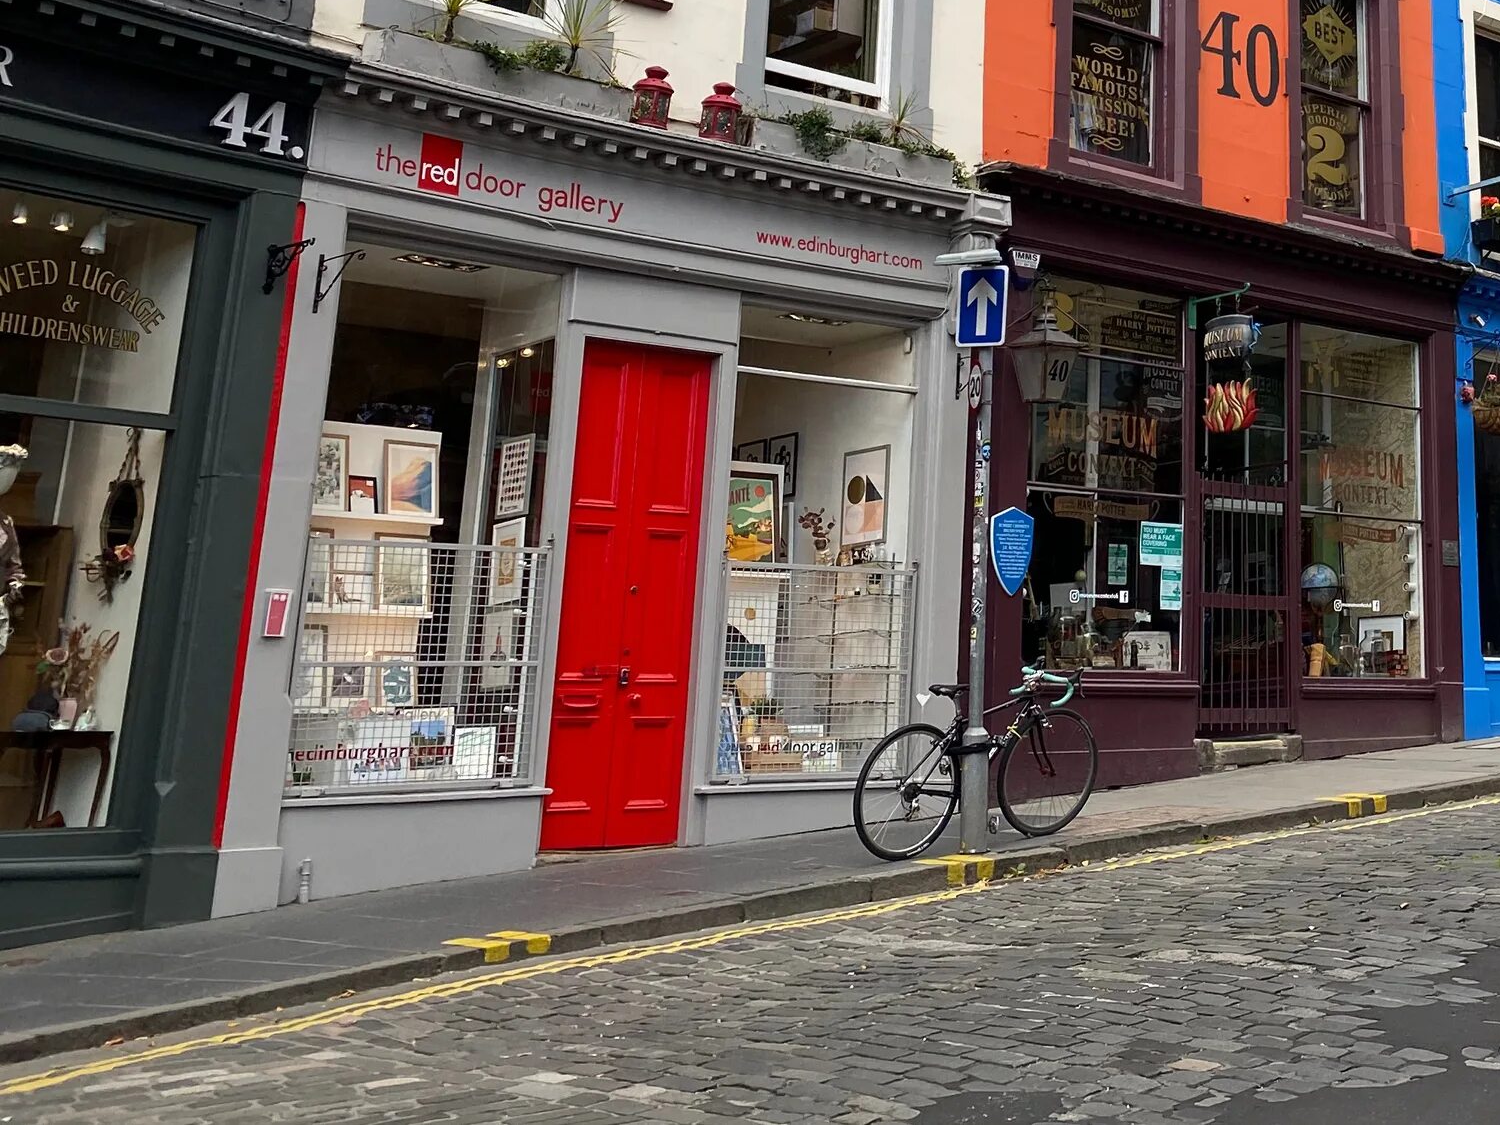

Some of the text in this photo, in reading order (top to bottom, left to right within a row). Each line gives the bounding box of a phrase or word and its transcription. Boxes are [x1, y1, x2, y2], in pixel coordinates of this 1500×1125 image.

[1314, 21, 1346, 46] BEST
[1076, 54, 1138, 84] WORLD
[1201, 11, 1280, 107] 40
[1071, 92, 1149, 121] MISSION
[1087, 113, 1136, 138] REE!
[1306, 125, 1347, 186] 2
[376, 143, 624, 224] the red door gallery
[1015, 252, 1038, 262] IMMS
[61, 294, 80, 314] &
[68, 260, 166, 334] LUGGAGE
[1116, 318, 1143, 330] HARRY
[1147, 324, 1176, 336] POTTER
[1050, 360, 1069, 382] 40
[970, 376, 980, 398] 20
[1150, 378, 1178, 391] CONTEXT
[1048, 406, 1158, 459] MUSEUM
[1067, 452, 1137, 479] CONTEXT
[1319, 447, 1404, 489] MUSEUM
[1334, 482, 1388, 506] CONTEXT
[1102, 502, 1126, 516] POTTER
